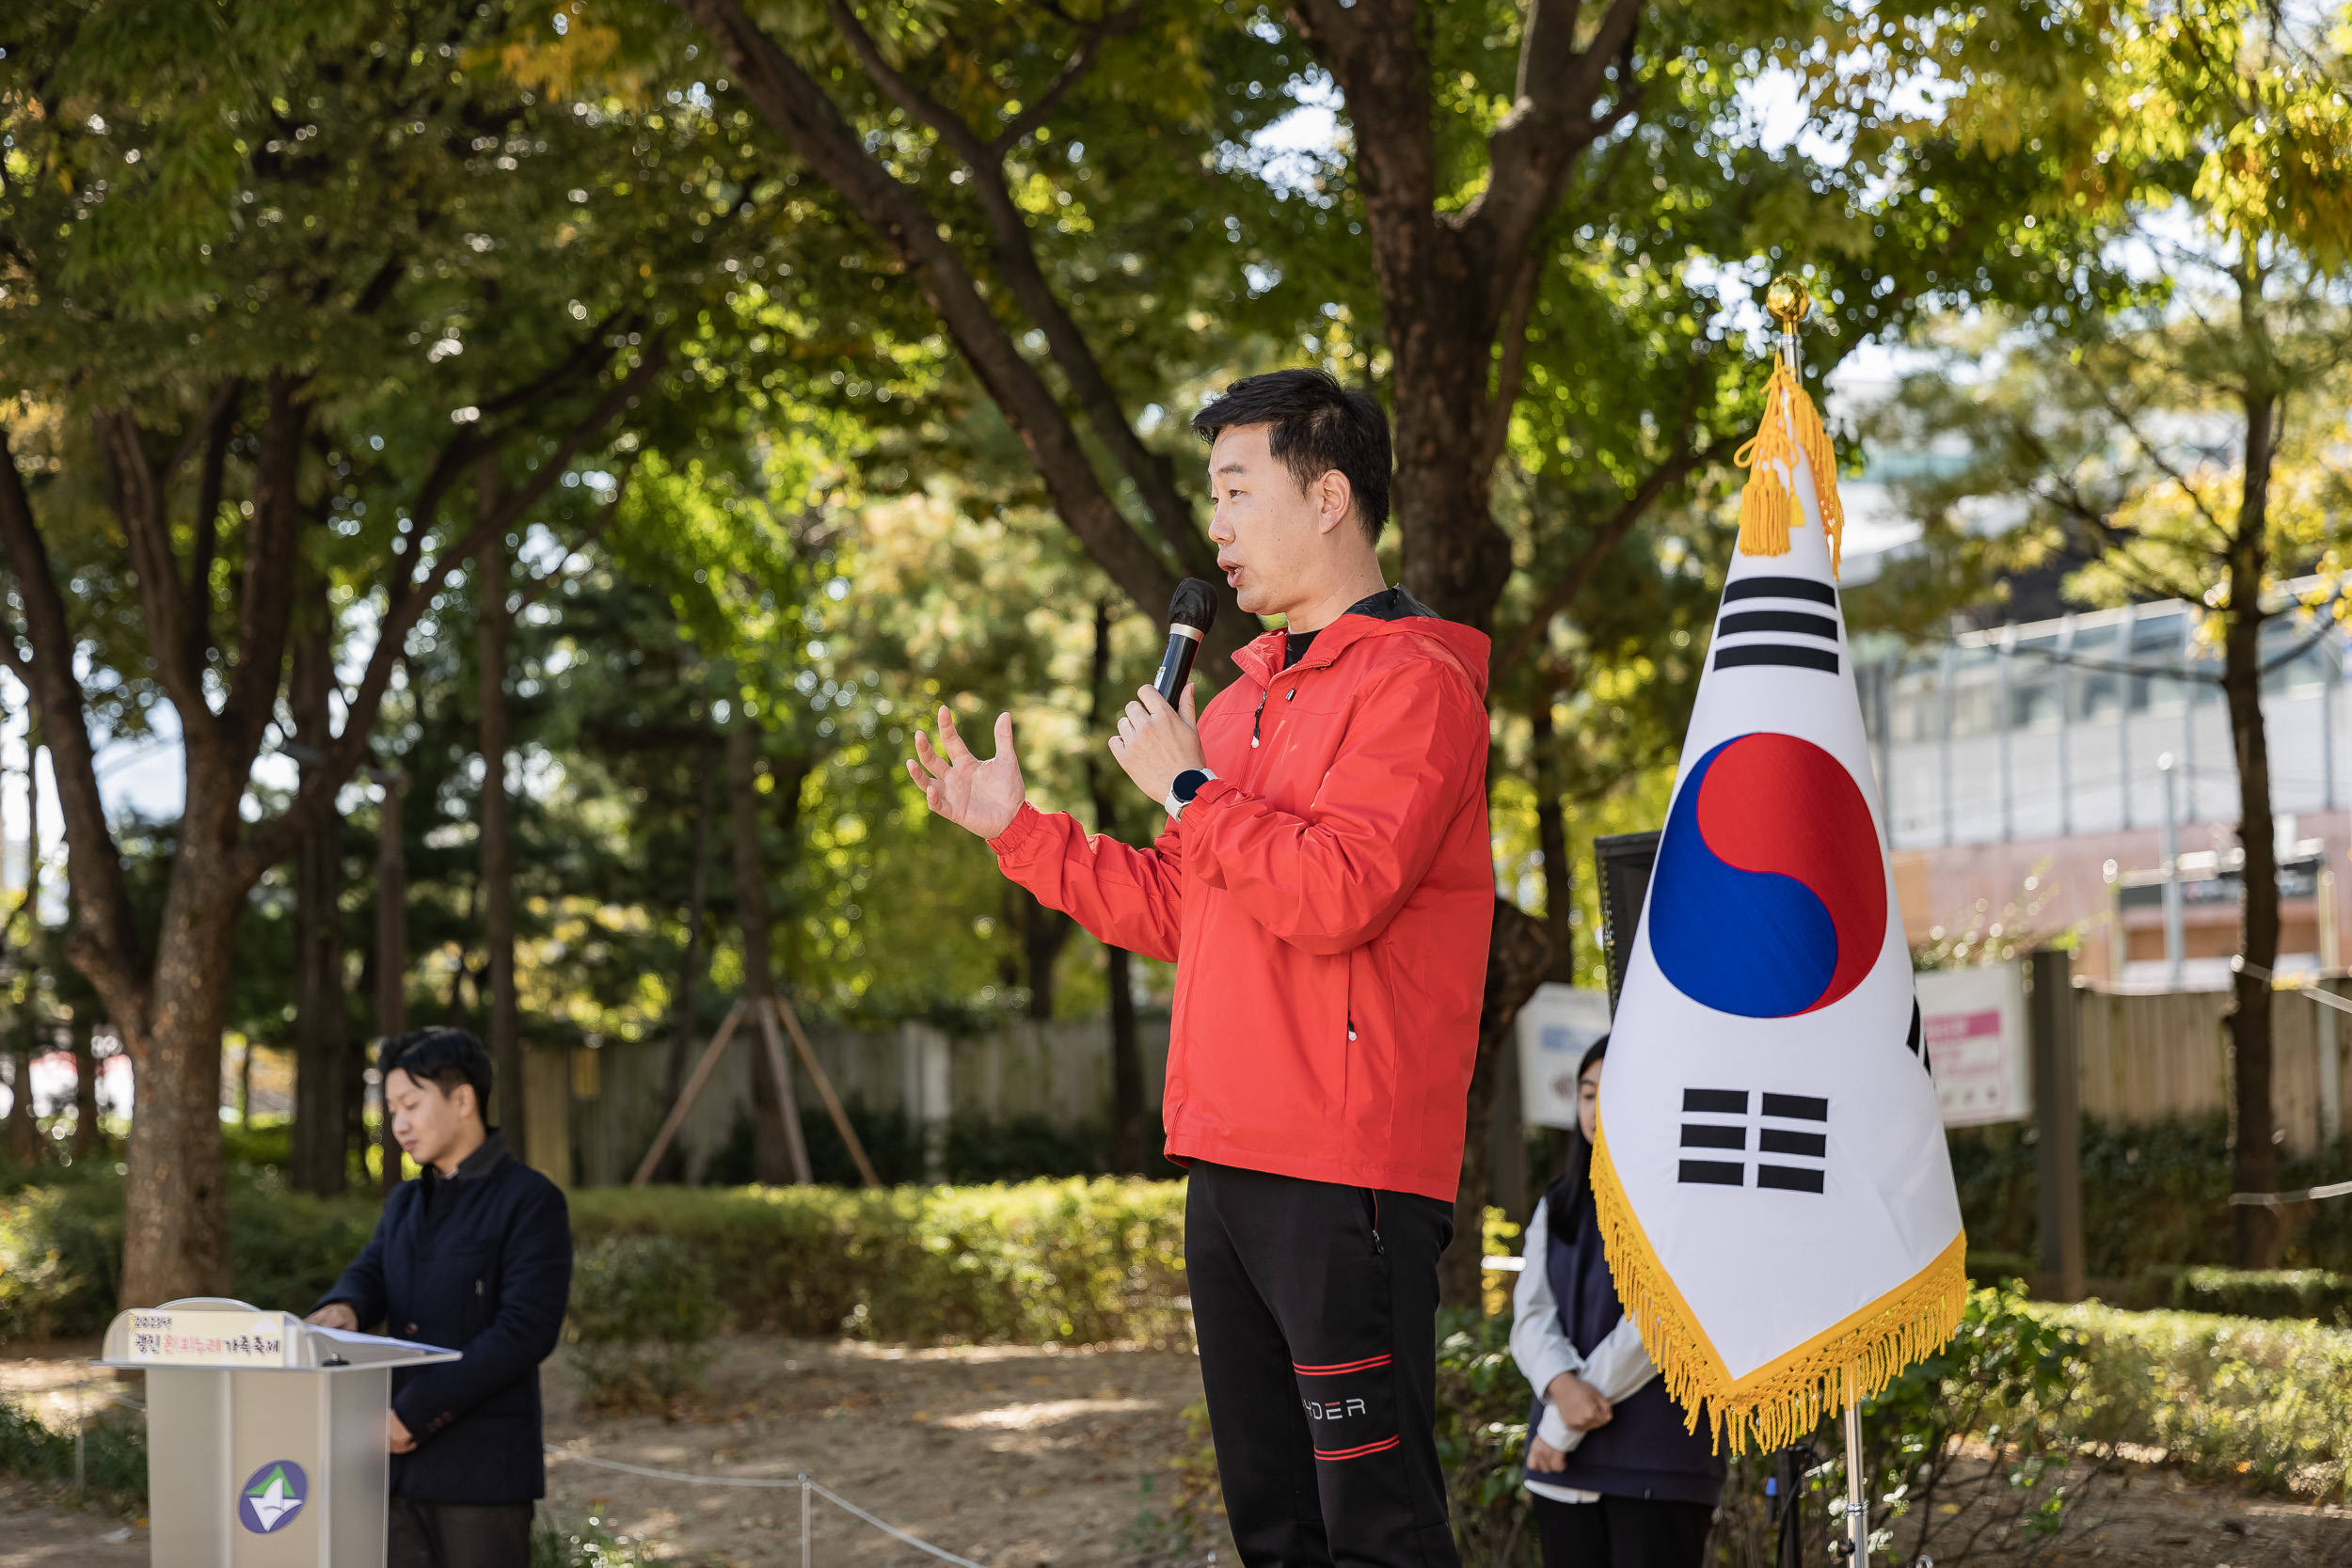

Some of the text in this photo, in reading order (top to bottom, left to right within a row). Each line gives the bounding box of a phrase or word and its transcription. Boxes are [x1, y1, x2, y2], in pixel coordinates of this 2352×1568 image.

[134, 1315, 171, 1330] 2023년
[222, 1334, 280, 1356] 가족축제
[1303, 1398, 1366, 1420] YDER
